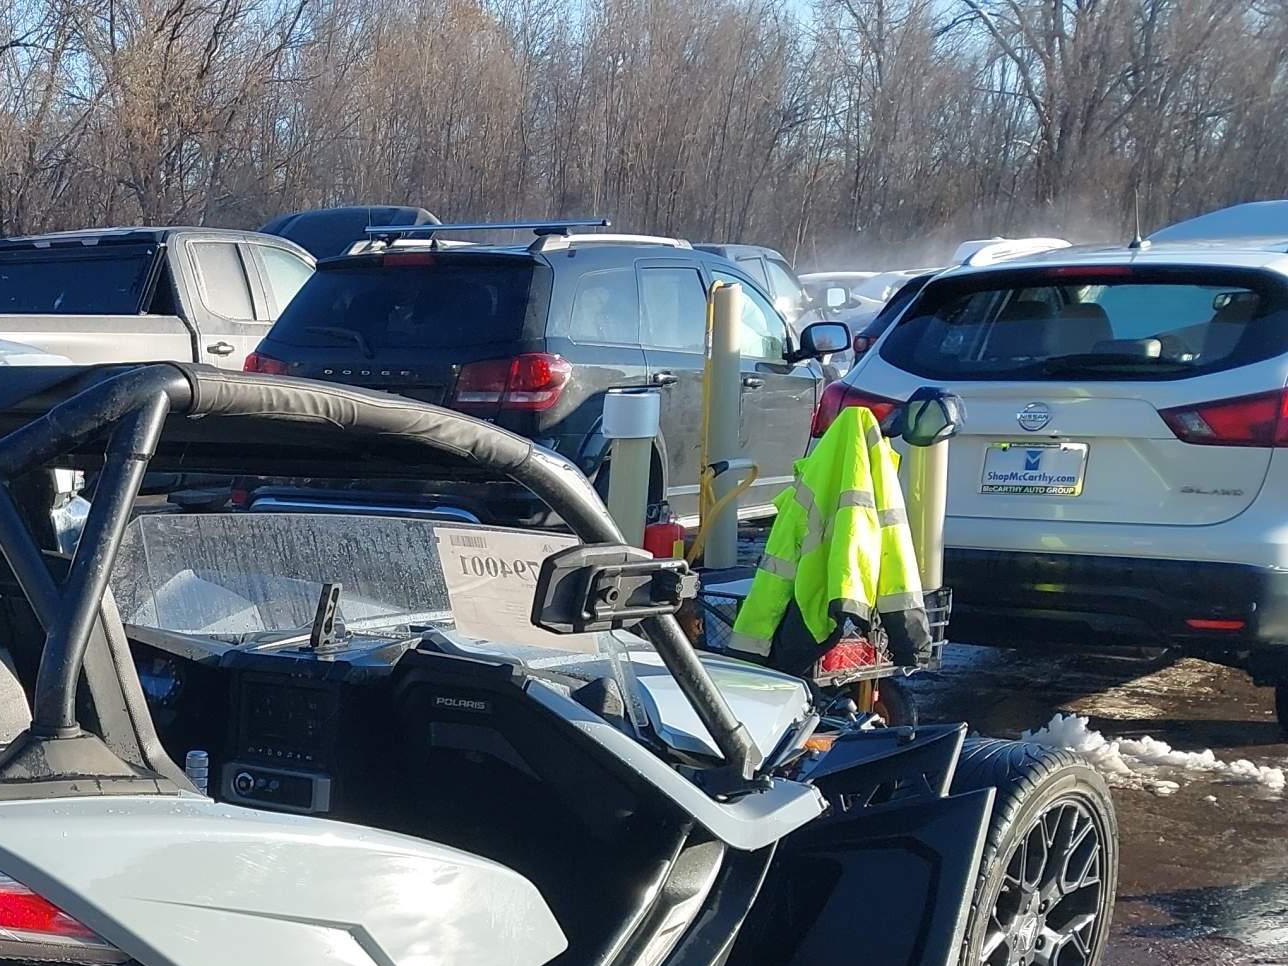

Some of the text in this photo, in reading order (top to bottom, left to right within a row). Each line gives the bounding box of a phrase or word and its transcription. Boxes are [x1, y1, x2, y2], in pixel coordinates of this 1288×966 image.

[324, 368, 410, 376] DODGE
[987, 471, 1076, 484] ShopMcCarthy.com
[983, 485, 1022, 493] McCARTHY
[436, 697, 486, 710] POLARIS
